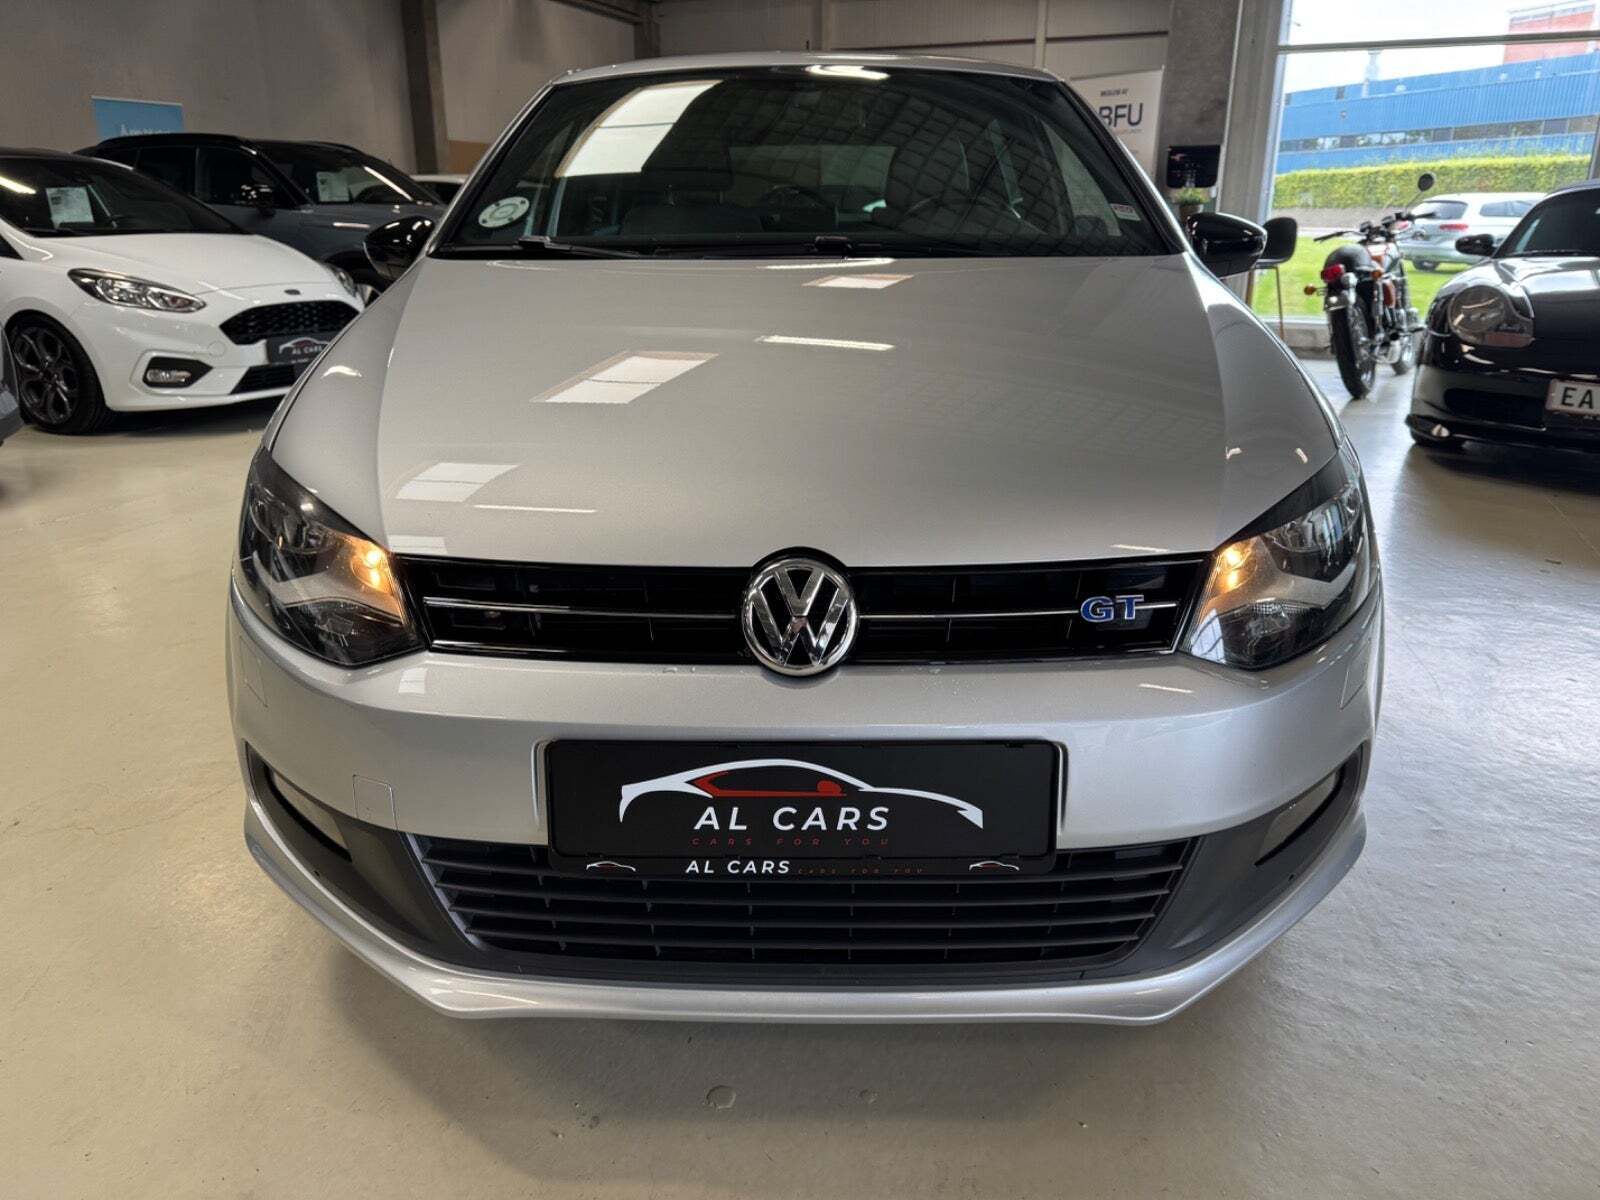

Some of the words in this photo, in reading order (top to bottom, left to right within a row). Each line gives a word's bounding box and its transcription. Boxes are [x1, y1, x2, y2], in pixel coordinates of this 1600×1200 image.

[1561, 386, 1595, 409] EA
[1080, 594, 1145, 623] GT
[693, 806, 748, 831] AL
[772, 806, 890, 831] CARS
[691, 837, 752, 846] CARS
[776, 837, 821, 846] FOR
[844, 837, 890, 846] YOU
[685, 860, 715, 874] AL
[727, 860, 791, 874] CARS
